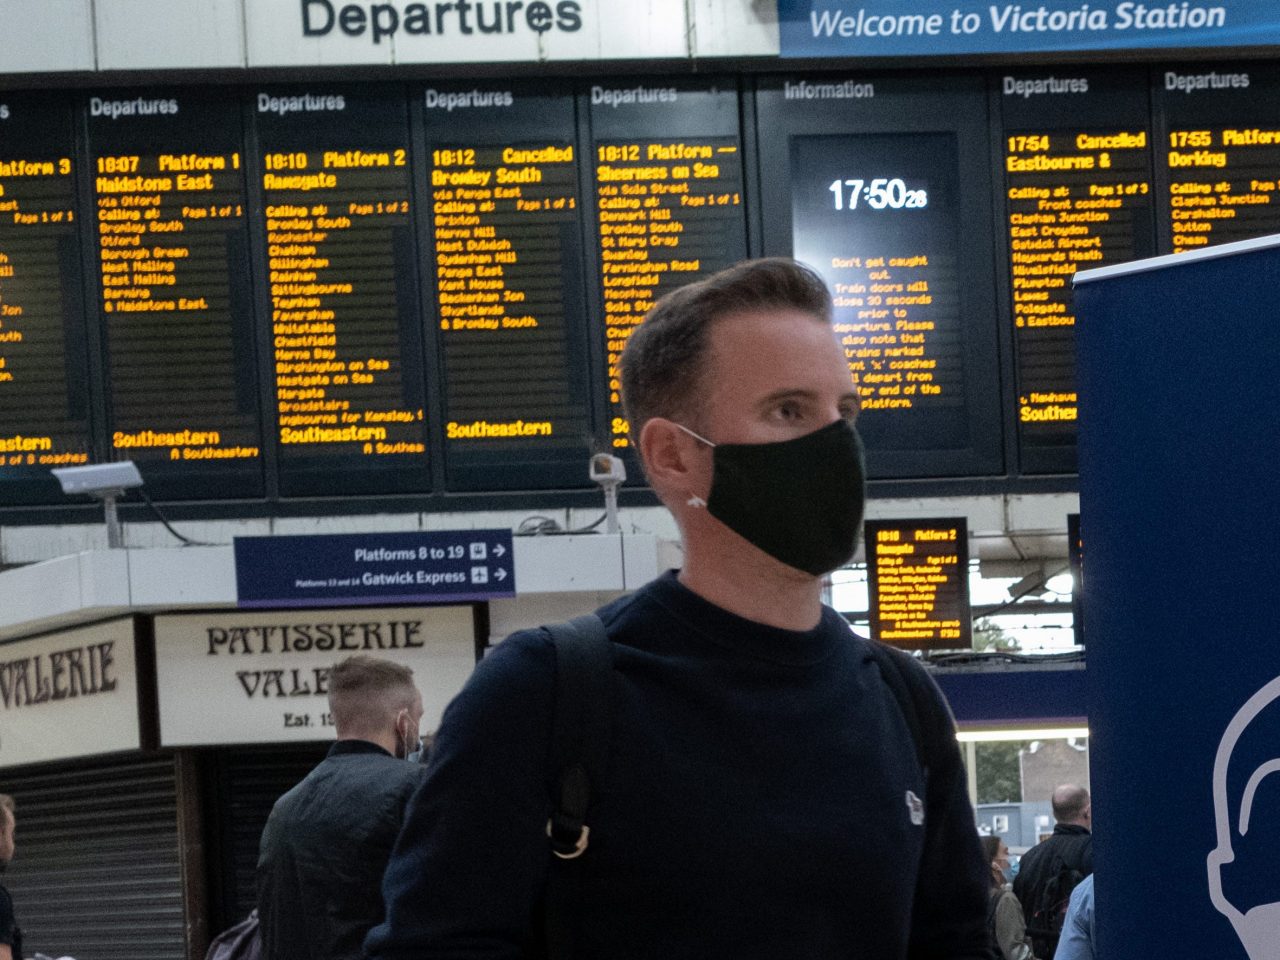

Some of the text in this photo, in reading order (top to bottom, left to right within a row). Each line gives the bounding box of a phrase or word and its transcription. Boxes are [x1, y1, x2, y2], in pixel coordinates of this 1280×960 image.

[301, 0, 582, 44] Departures
[811, 2, 1225, 37] Welcome to Victoria Station
[784, 81, 874, 99] Information
[1004, 77, 1088, 98] Departures
[1165, 72, 1250, 93] Departures
[258, 94, 345, 116] Departures
[426, 90, 513, 110] Departures
[591, 87, 678, 107] Departures
[91, 98, 178, 119] Departures
[1076, 132, 1146, 150] Cancelled
[323, 152, 390, 168] Platform
[394, 149, 405, 166] 2
[502, 147, 573, 164] Cancelled
[647, 144, 712, 160] Platform
[1168, 150, 1227, 167] Dorking
[159, 155, 225, 171] Platform
[232, 153, 240, 169] 1
[1006, 155, 1095, 172] Eastbourne
[432, 167, 542, 186] Bromley South
[597, 166, 668, 182] Sheerness
[693, 163, 719, 178] Sea
[96, 174, 213, 193] Maidstone East
[889, 255, 927, 267] caught
[834, 284, 865, 293] Train
[870, 282, 903, 292] doors
[858, 309, 906, 319] prior to
[895, 321, 934, 331] Please
[870, 335, 896, 344] note
[901, 334, 925, 343] that
[280, 426, 387, 443] Southeastern
[447, 421, 552, 438] Southeastern
[113, 431, 220, 447] Southeastern
[354, 544, 464, 562] Platforms 8 to 19
[362, 570, 414, 586] Gatwick
[416, 569, 466, 586] Express
[207, 621, 425, 655] PATISSERIE
[0, 640, 118, 707] VALERIE
[235, 668, 328, 698] VALE
